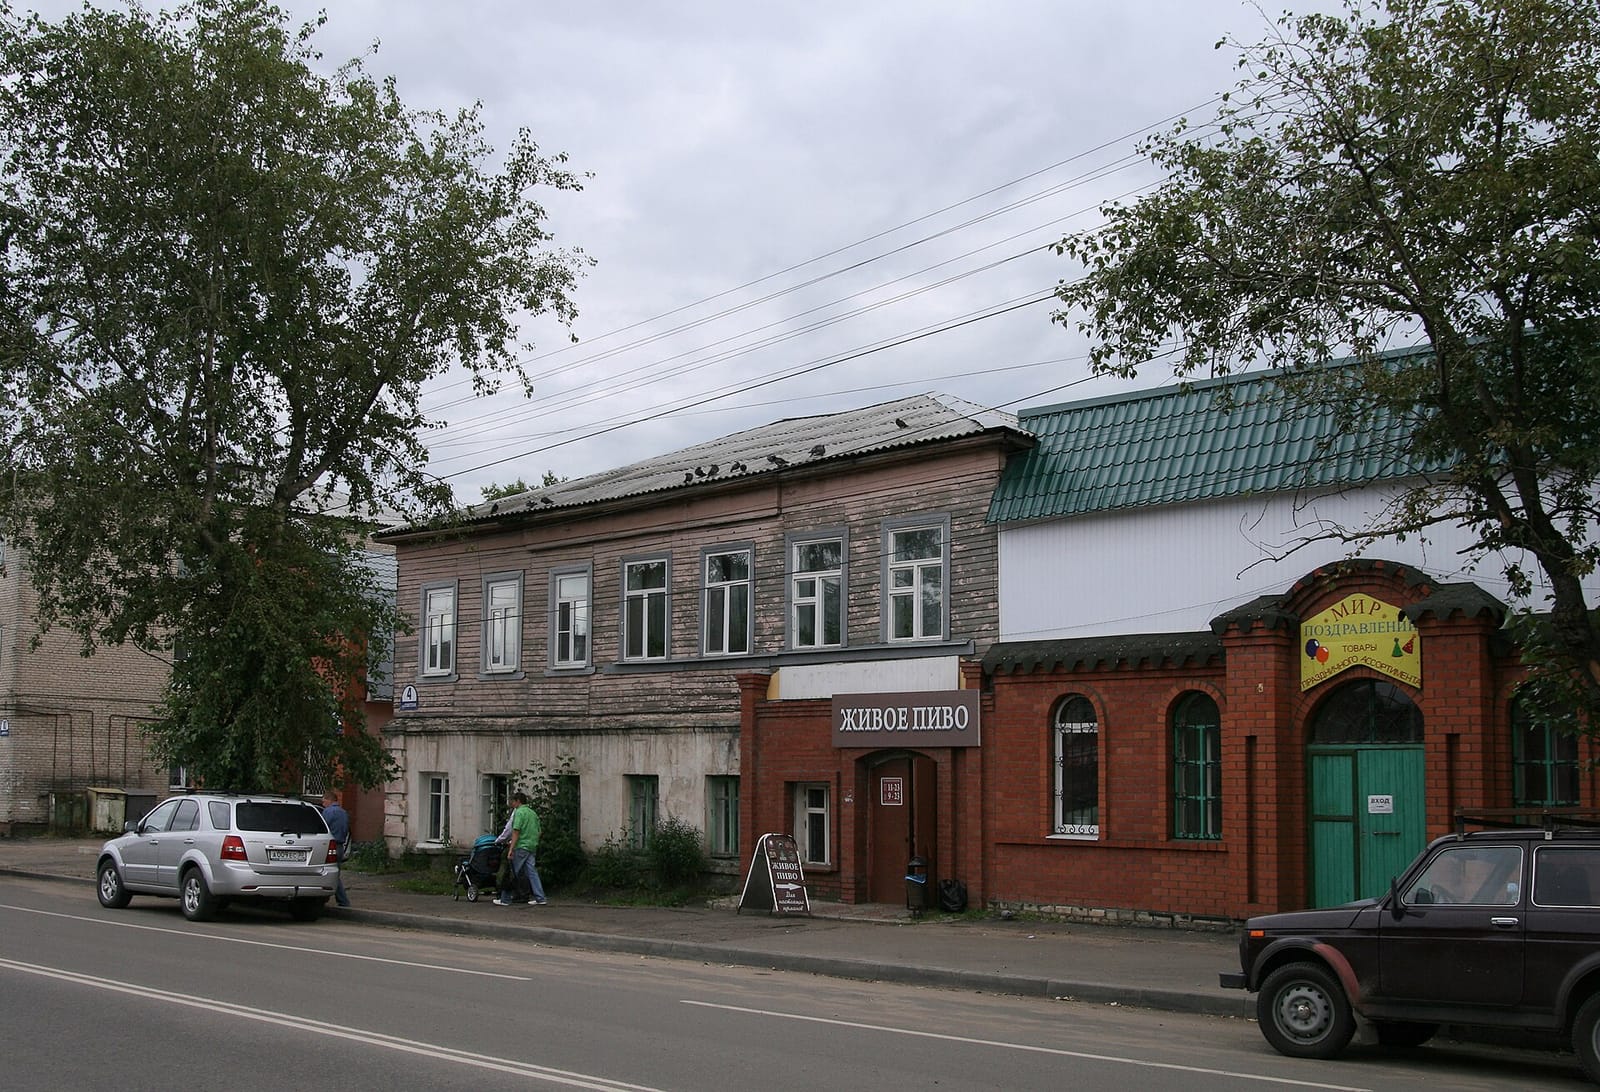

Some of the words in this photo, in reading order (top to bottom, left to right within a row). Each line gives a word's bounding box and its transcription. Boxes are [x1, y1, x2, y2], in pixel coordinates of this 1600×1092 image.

[1330, 599, 1382, 622] МИР
[1342, 643, 1378, 653] ТОВАРЫ
[1301, 655, 1359, 689] ПРАЗДНИЧНОГО
[406, 687, 412, 700] 4
[839, 707, 909, 732] ЖИВОЕ
[912, 705, 969, 731] ПИВО
[771, 862, 799, 871] ЖИВОЕ
[776, 872, 798, 880] ПИВО
